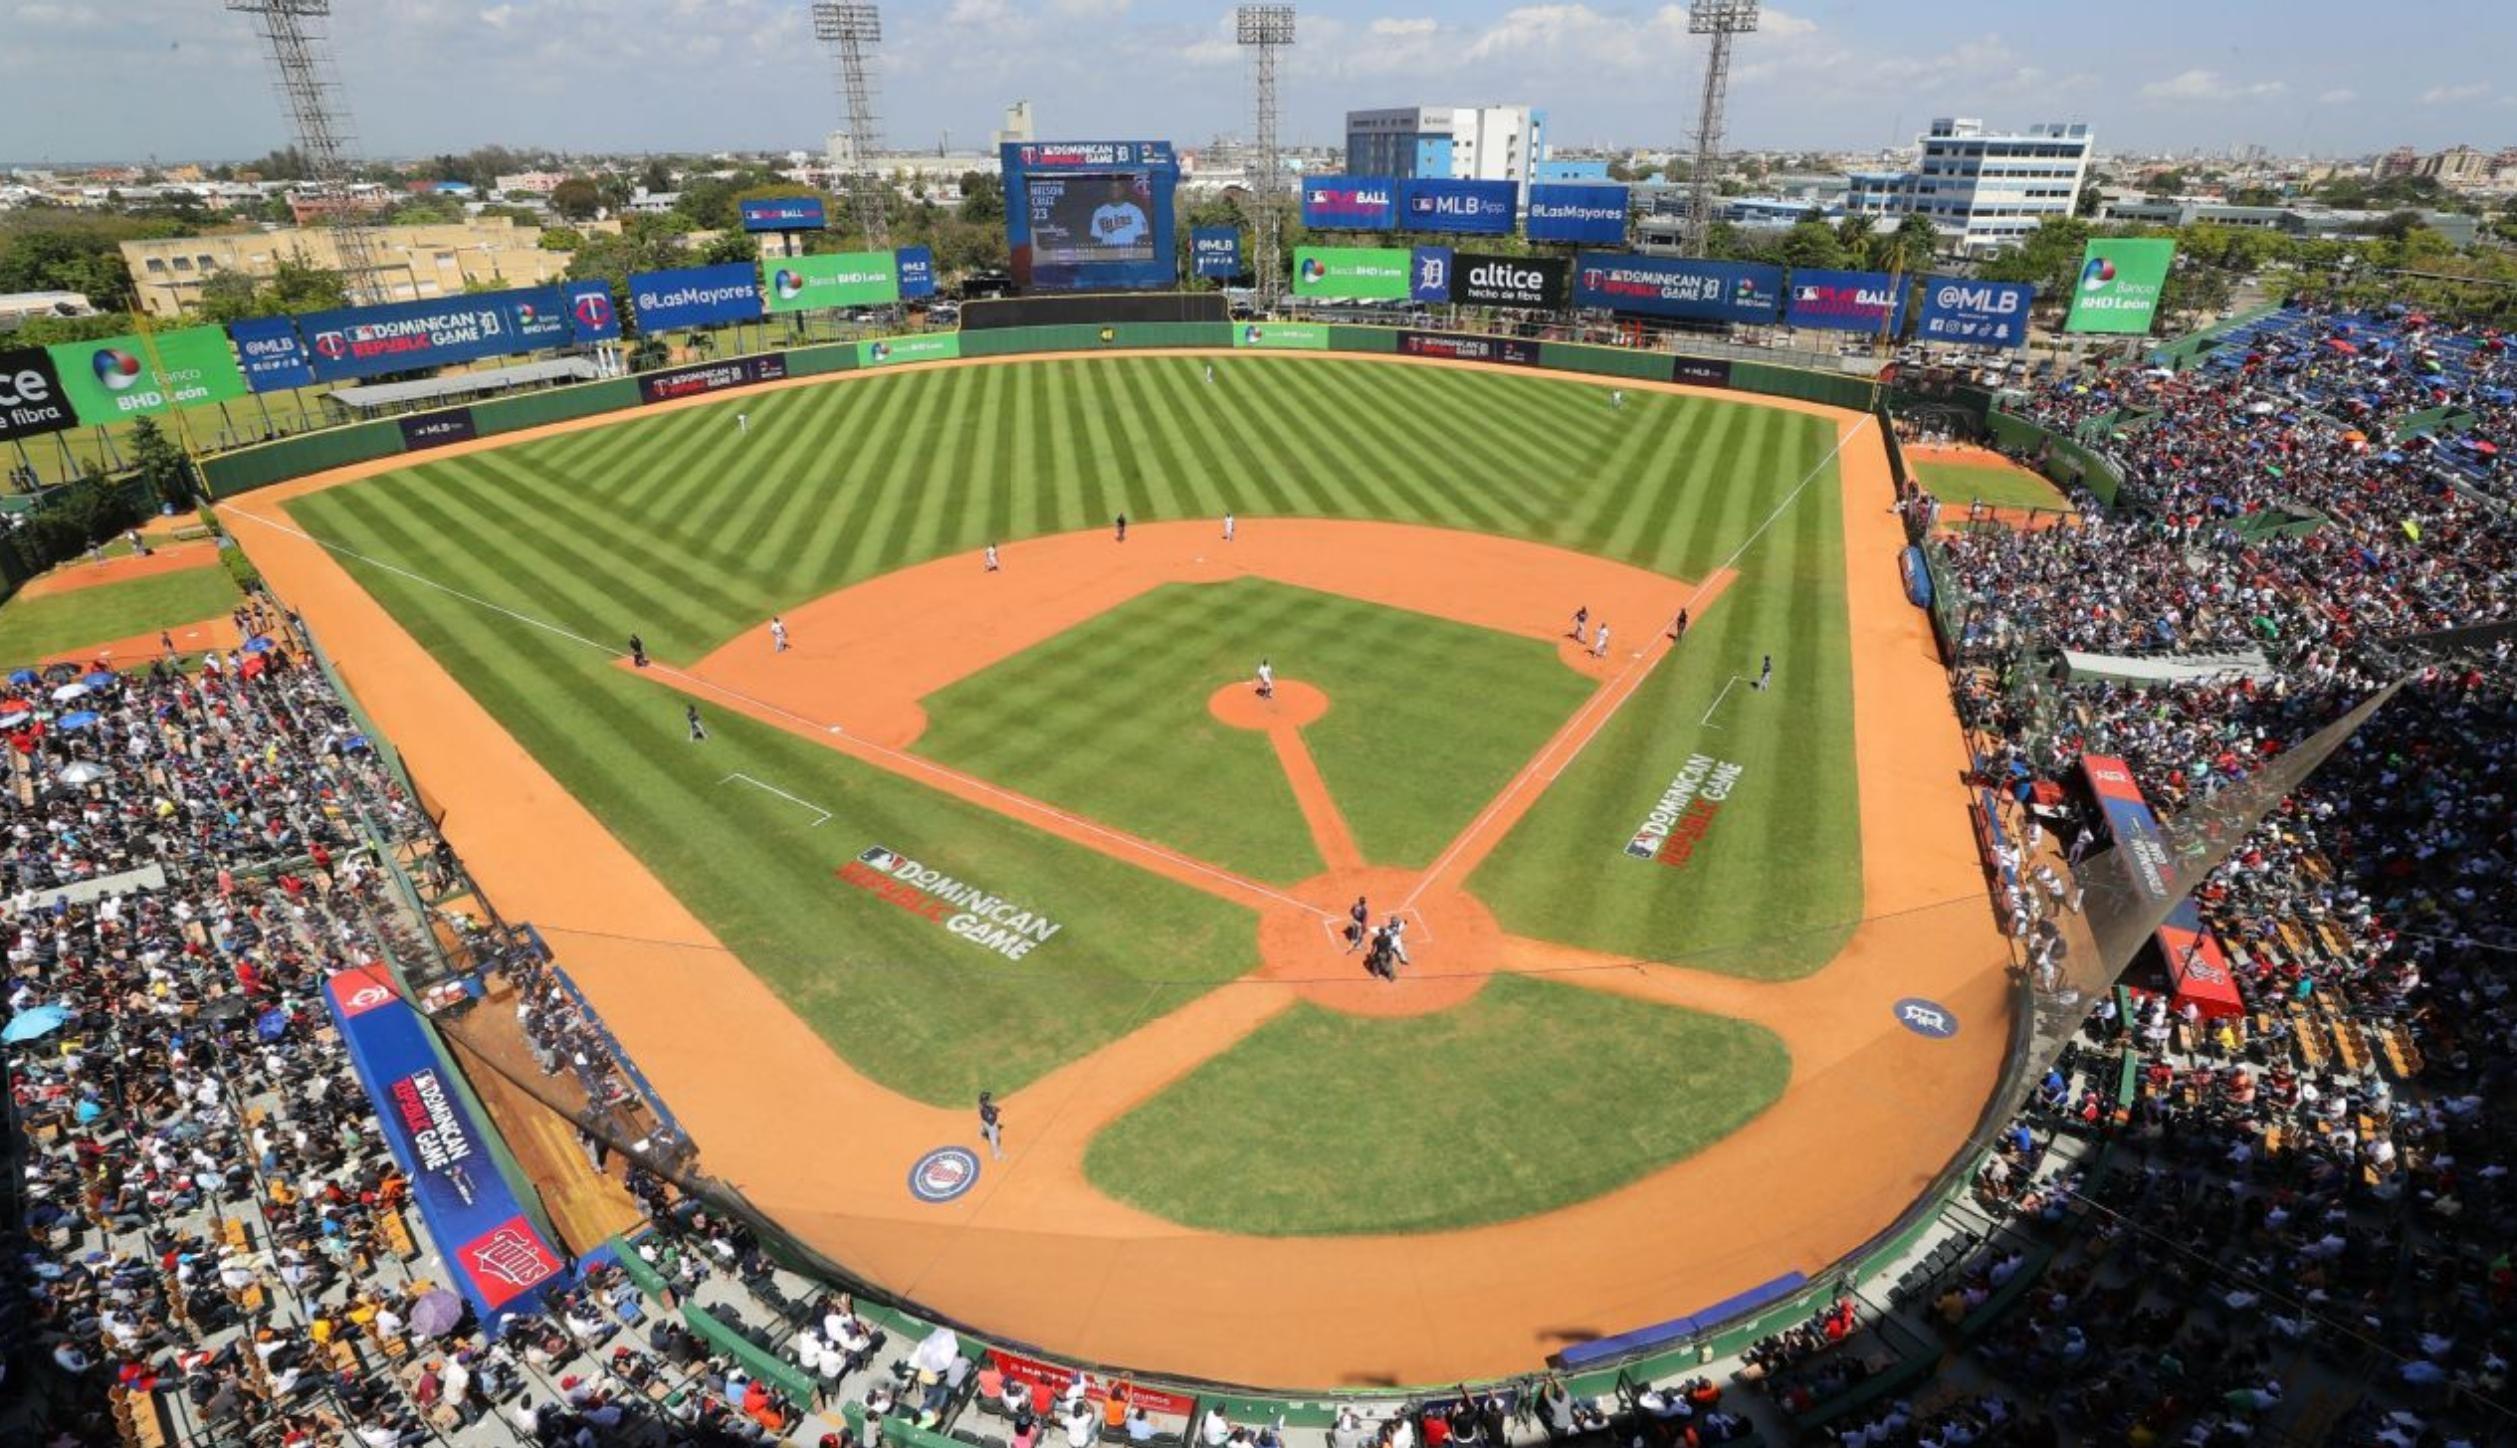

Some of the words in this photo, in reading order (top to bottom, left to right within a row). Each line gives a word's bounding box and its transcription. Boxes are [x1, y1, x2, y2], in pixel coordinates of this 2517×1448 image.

[1436, 196, 1479, 215] MLB
[1531, 203, 1622, 220] @LasMayores
[1469, 262, 1543, 289] altice
[1626, 269, 1701, 287] DOMINICAN
[640, 284, 755, 311] @LasMayores
[1468, 287, 1499, 299] hecho
[1501, 290, 1515, 299] de
[1661, 286, 1699, 300] GAME
[1937, 285, 2019, 314] @MLB
[2081, 297, 2113, 309] BHD
[374, 311, 475, 339] DOMINICAN
[431, 327, 480, 346] GAME
[246, 336, 295, 356] @MLB
[116, 391, 162, 411] BHD
[10, 405, 62, 426] fibra
[1700, 761, 1743, 801] GAME
[1640, 753, 1715, 837] DOMINICAN
[893, 860, 1062, 942] DOMINICAN
[946, 913, 1038, 961] GAME
[420, 1084, 472, 1161] DOMINICAN
[415, 1129, 449, 1171] GAME
[472, 1229, 551, 1286] Twins
